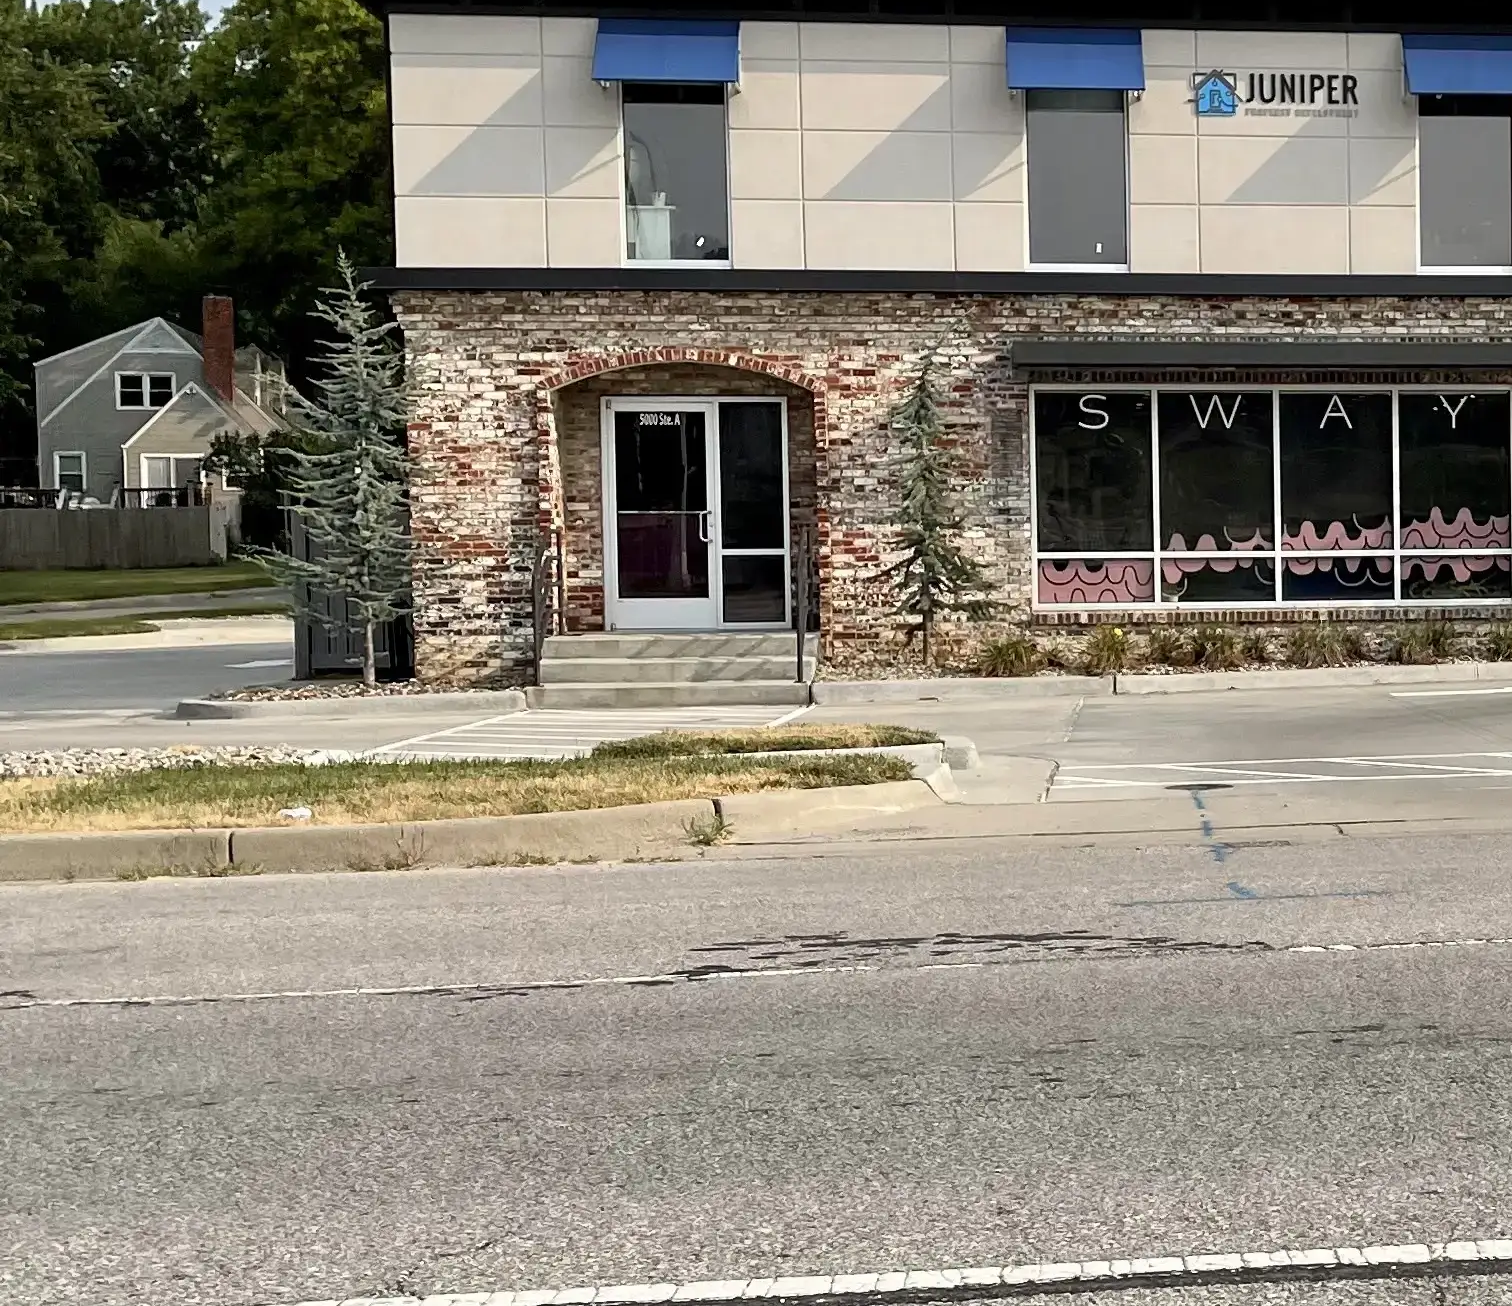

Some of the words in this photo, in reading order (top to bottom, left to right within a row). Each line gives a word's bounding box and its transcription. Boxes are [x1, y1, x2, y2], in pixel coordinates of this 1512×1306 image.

[1245, 73, 1359, 105] JUNIPER
[639, 413, 658, 426] 5000
[674, 412, 681, 426] A
